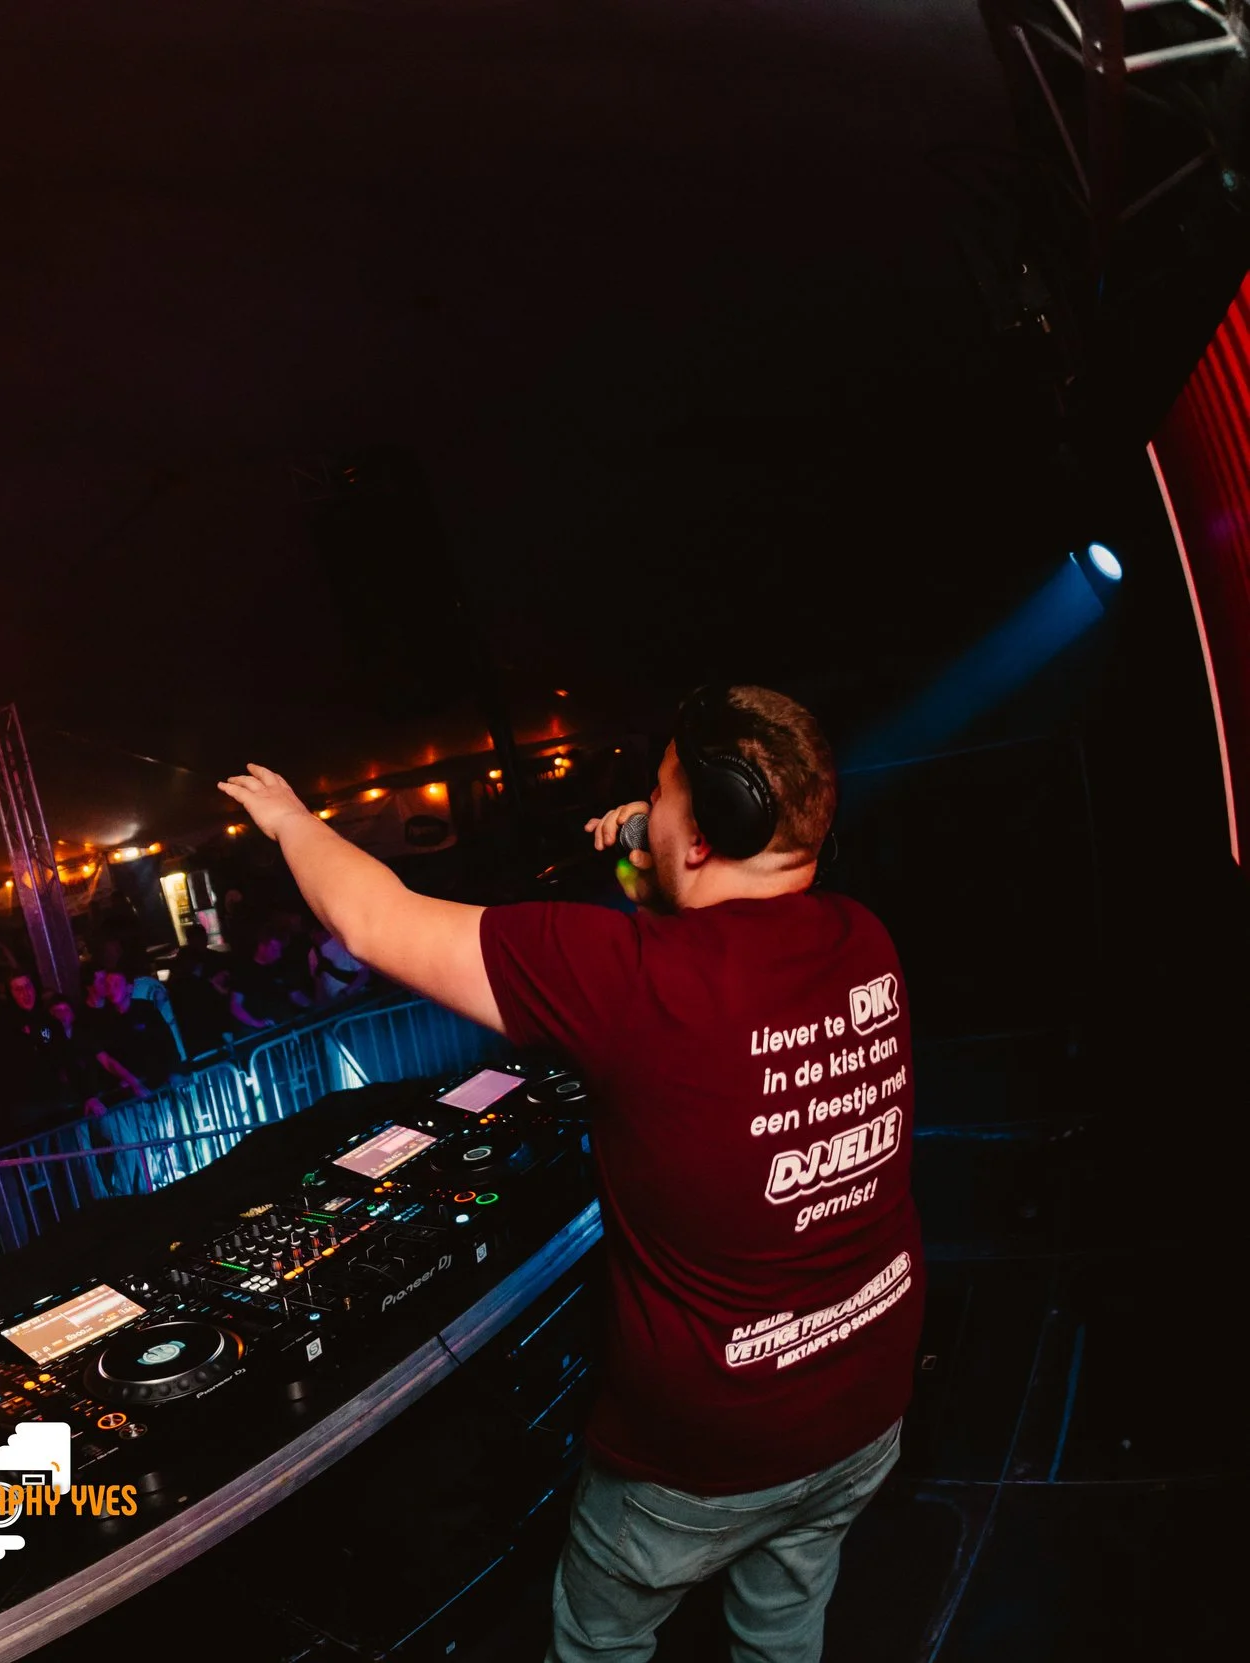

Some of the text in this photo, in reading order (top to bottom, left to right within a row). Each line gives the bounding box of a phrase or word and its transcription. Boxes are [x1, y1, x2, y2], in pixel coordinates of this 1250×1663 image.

[751, 977, 894, 1056] Liever te DIK
[763, 1036, 898, 1095] in de kist dan
[750, 1065, 906, 1137] een feestje met
[795, 1177, 878, 1232] gemist!
[381, 1266, 436, 1312] Pioneer
[728, 1253, 908, 1362] VETTIGE FRIKANDELLIES
[839, 1322, 851, 1339] @
[851, 1276, 912, 1330] SOUNDCLOUD
[732, 1324, 752, 1342] DJ
